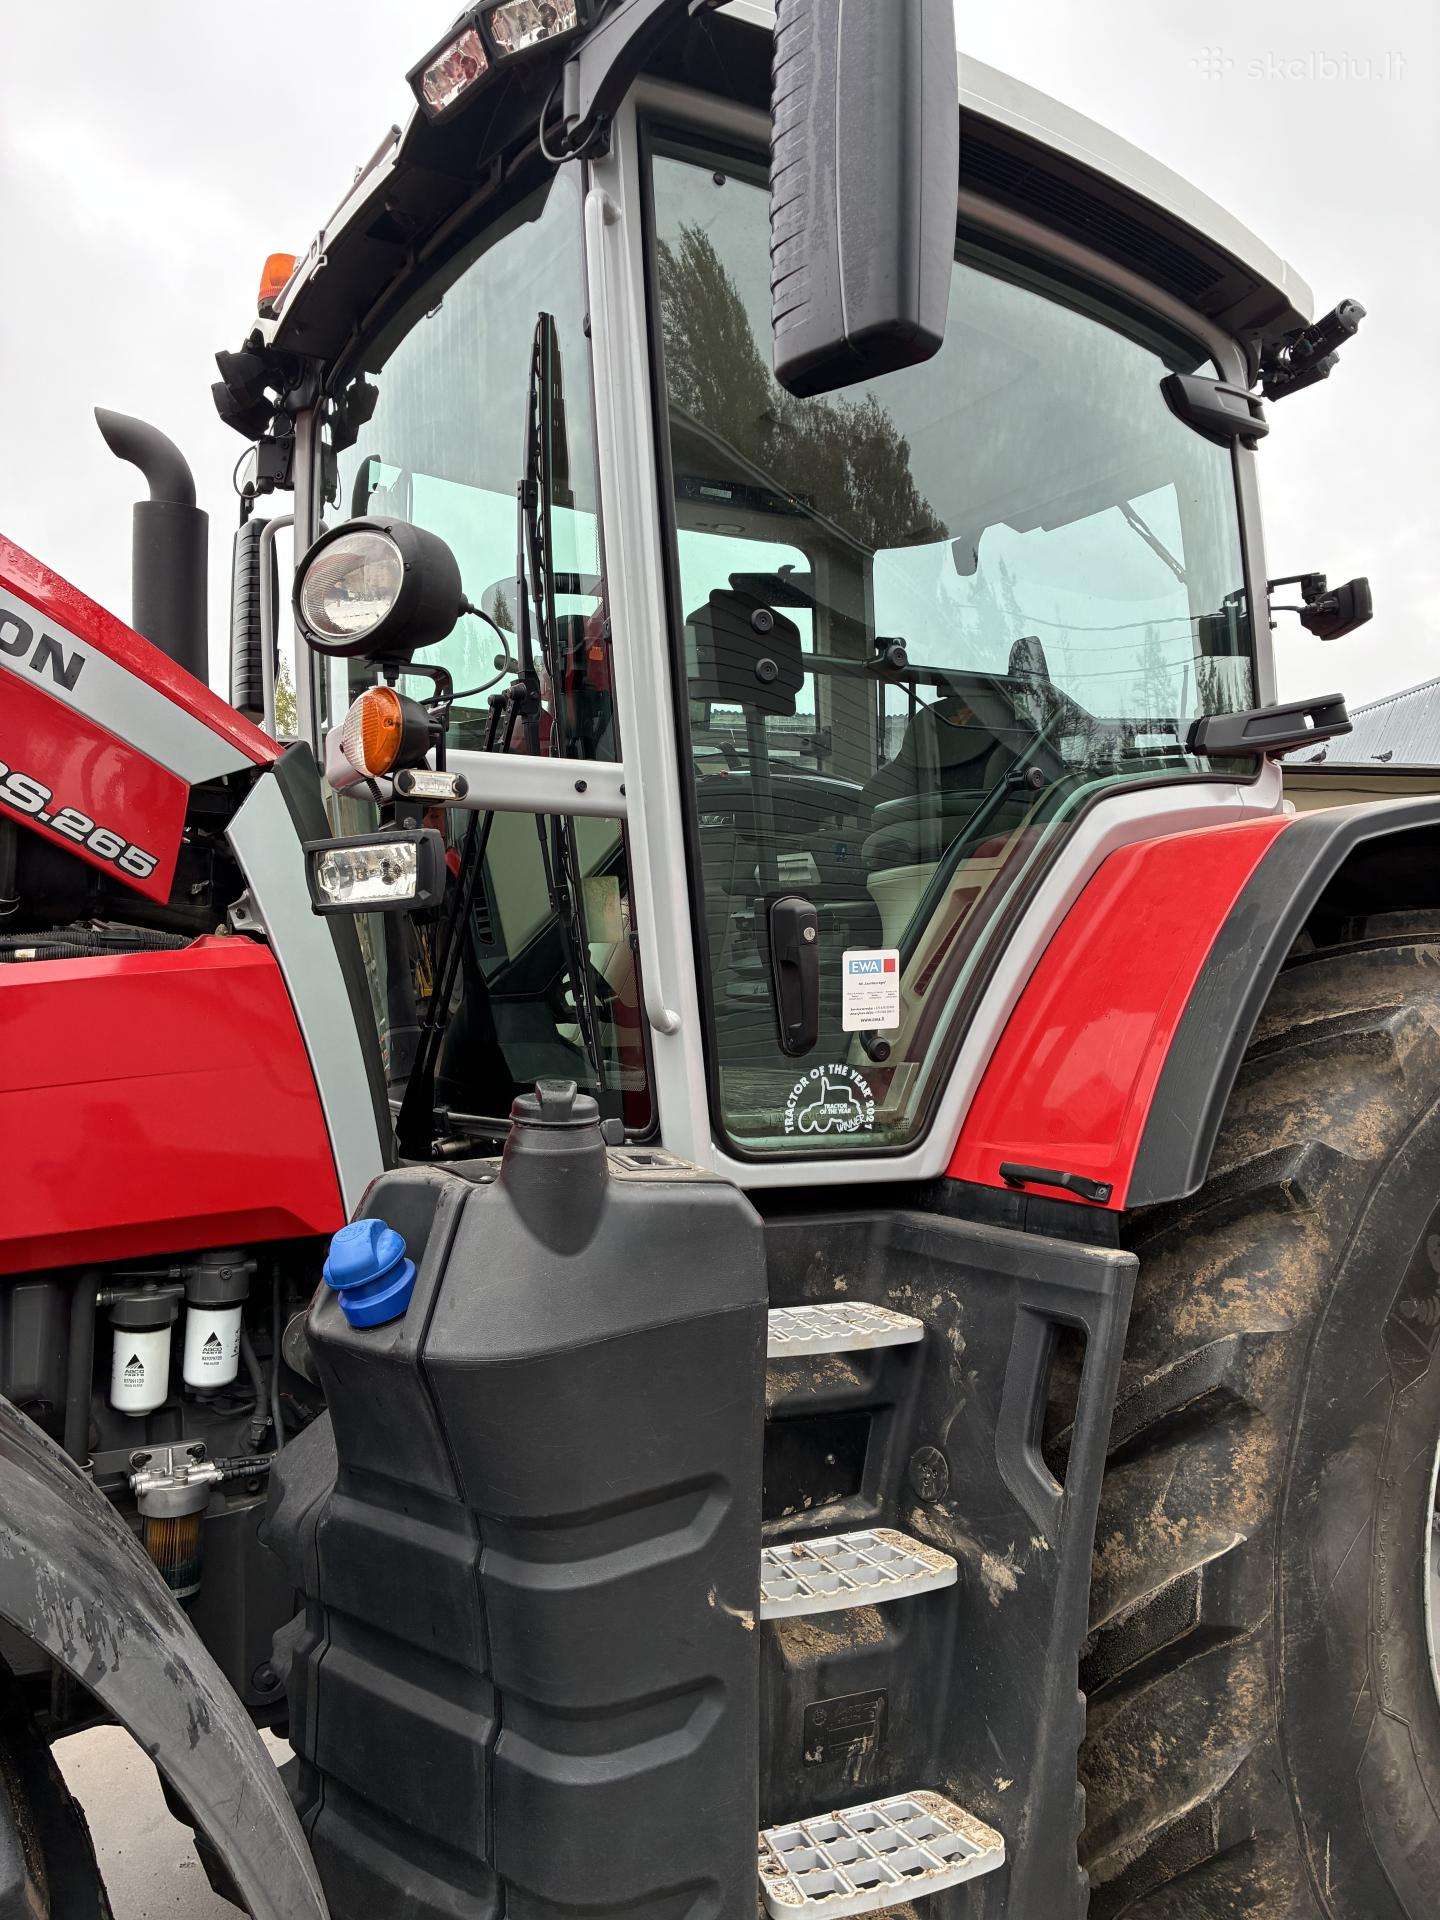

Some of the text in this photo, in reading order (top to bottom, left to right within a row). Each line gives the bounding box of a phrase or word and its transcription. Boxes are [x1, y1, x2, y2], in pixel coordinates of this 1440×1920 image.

[0, 608, 86, 692] ON
[0, 759, 160, 879] S.265
[851, 961, 879, 973] EWA
[785, 1076, 810, 1134] TRACTOR
[809, 1065, 825, 1079] OF
[828, 1064, 849, 1077] THE
[849, 1069, 873, 1098] YEAR
[836, 1114, 866, 1133] WINNER
